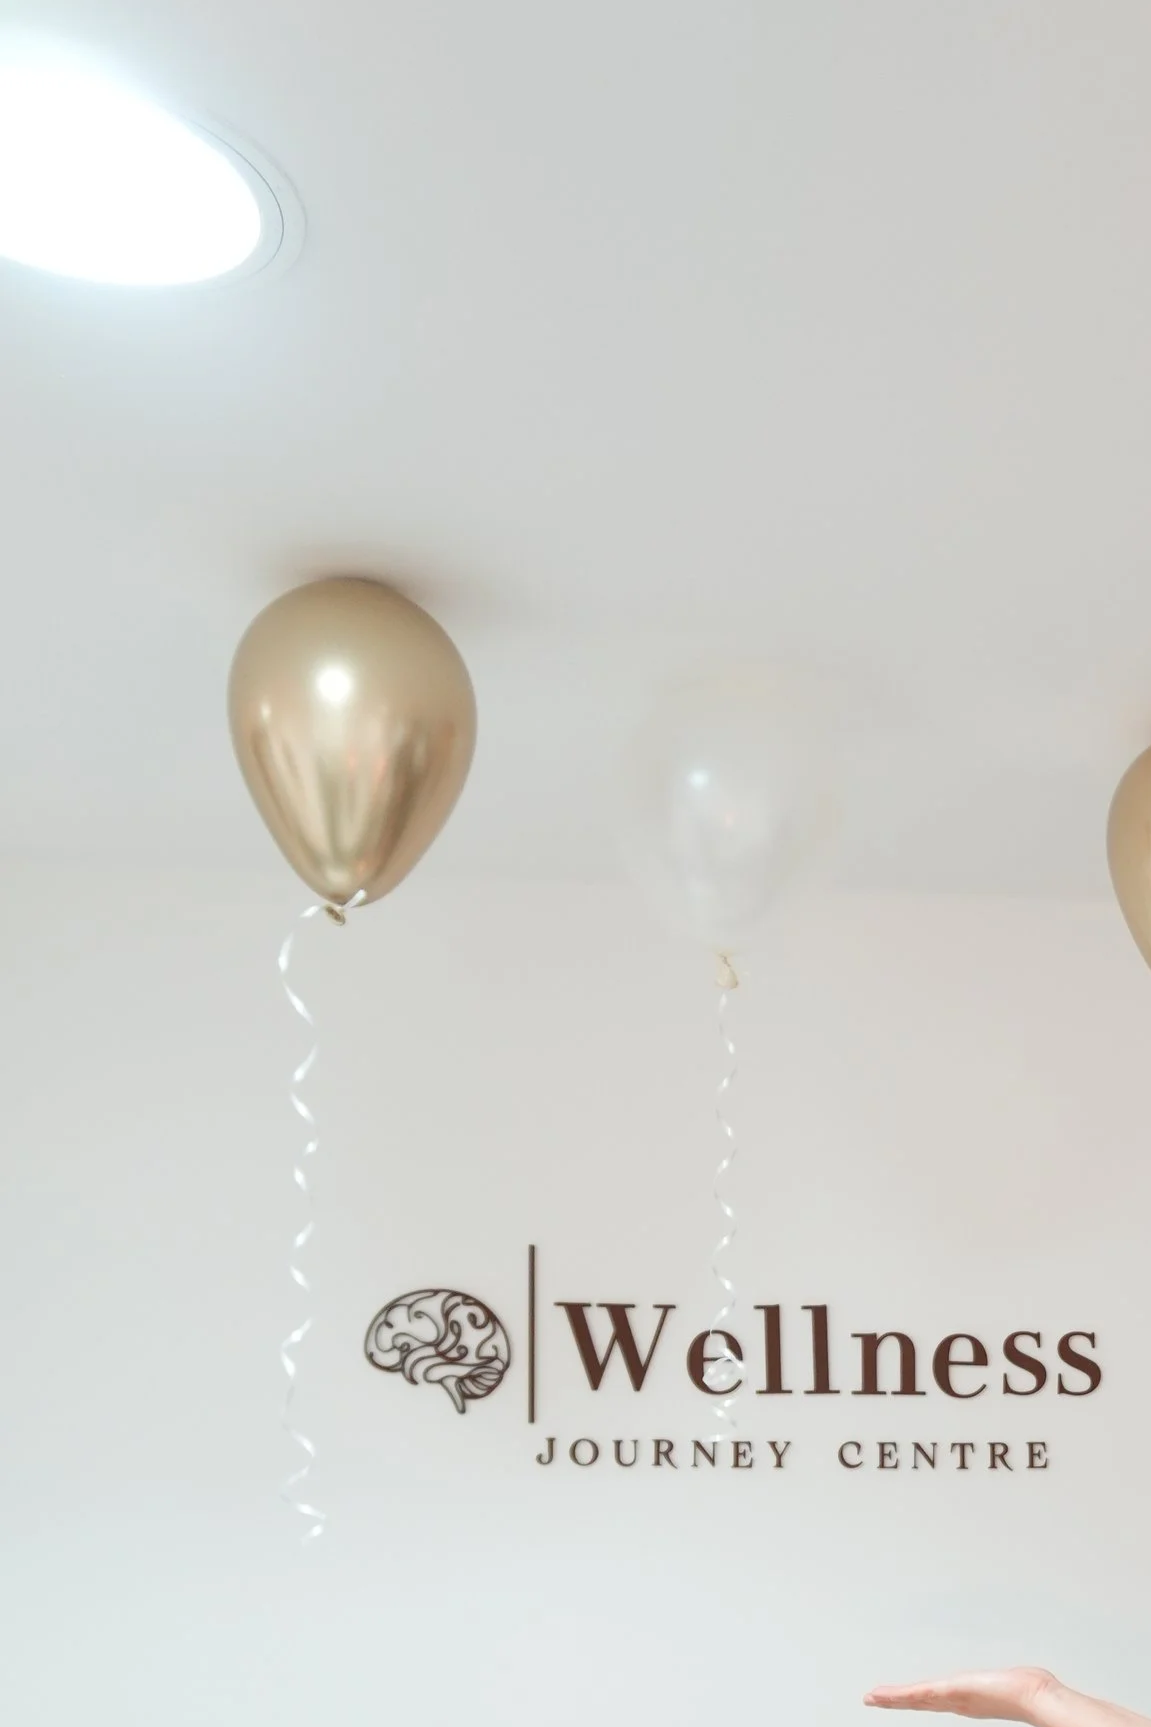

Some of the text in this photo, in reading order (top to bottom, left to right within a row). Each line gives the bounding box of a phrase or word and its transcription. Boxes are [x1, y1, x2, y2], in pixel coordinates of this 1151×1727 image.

[553, 1302, 1103, 1399] Wellness
[535, 1436, 1051, 1471] JOURNEY CENTRE
